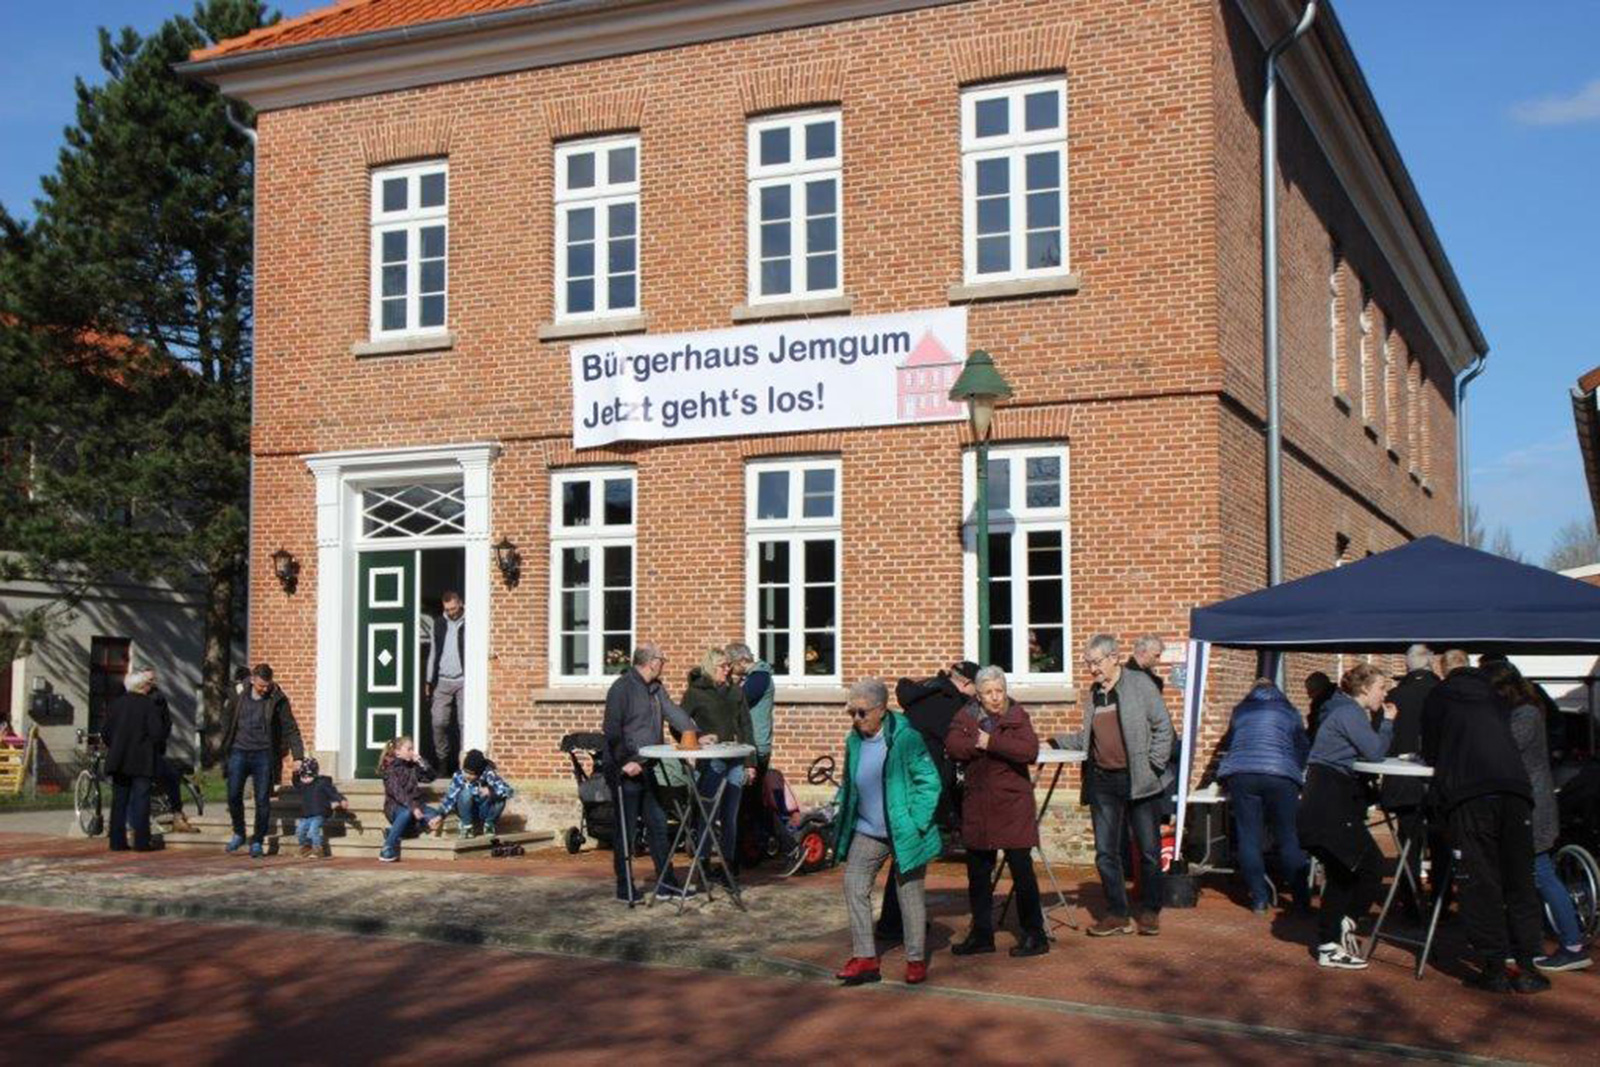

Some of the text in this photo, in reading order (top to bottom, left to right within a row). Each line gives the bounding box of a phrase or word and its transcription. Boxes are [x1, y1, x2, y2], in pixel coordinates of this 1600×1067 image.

[582, 330, 911, 382] Bürgerhaus Jemgum
[769, 382, 825, 414] los!
